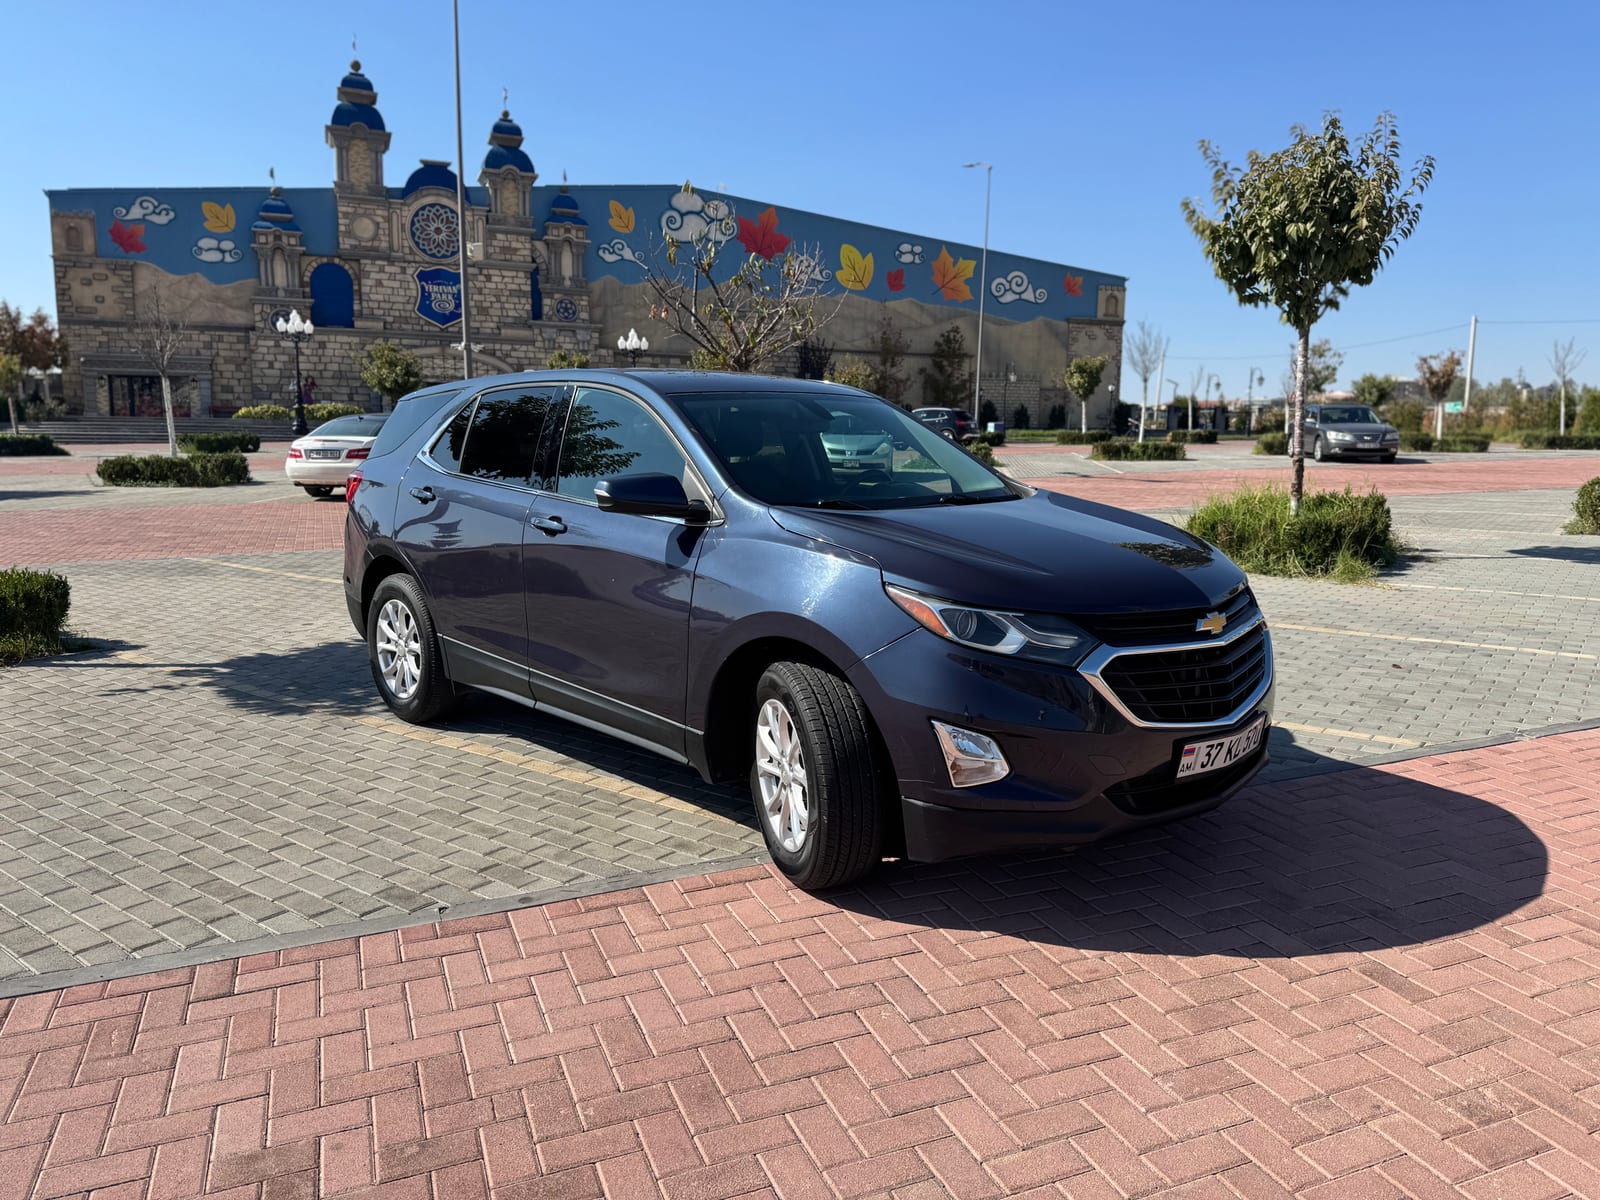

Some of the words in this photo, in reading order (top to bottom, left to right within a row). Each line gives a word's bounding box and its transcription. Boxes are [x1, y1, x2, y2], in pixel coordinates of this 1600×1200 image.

[1201, 742, 1224, 769] 37
[1224, 736, 1242, 763] KL
[1179, 762, 1193, 774] AM
